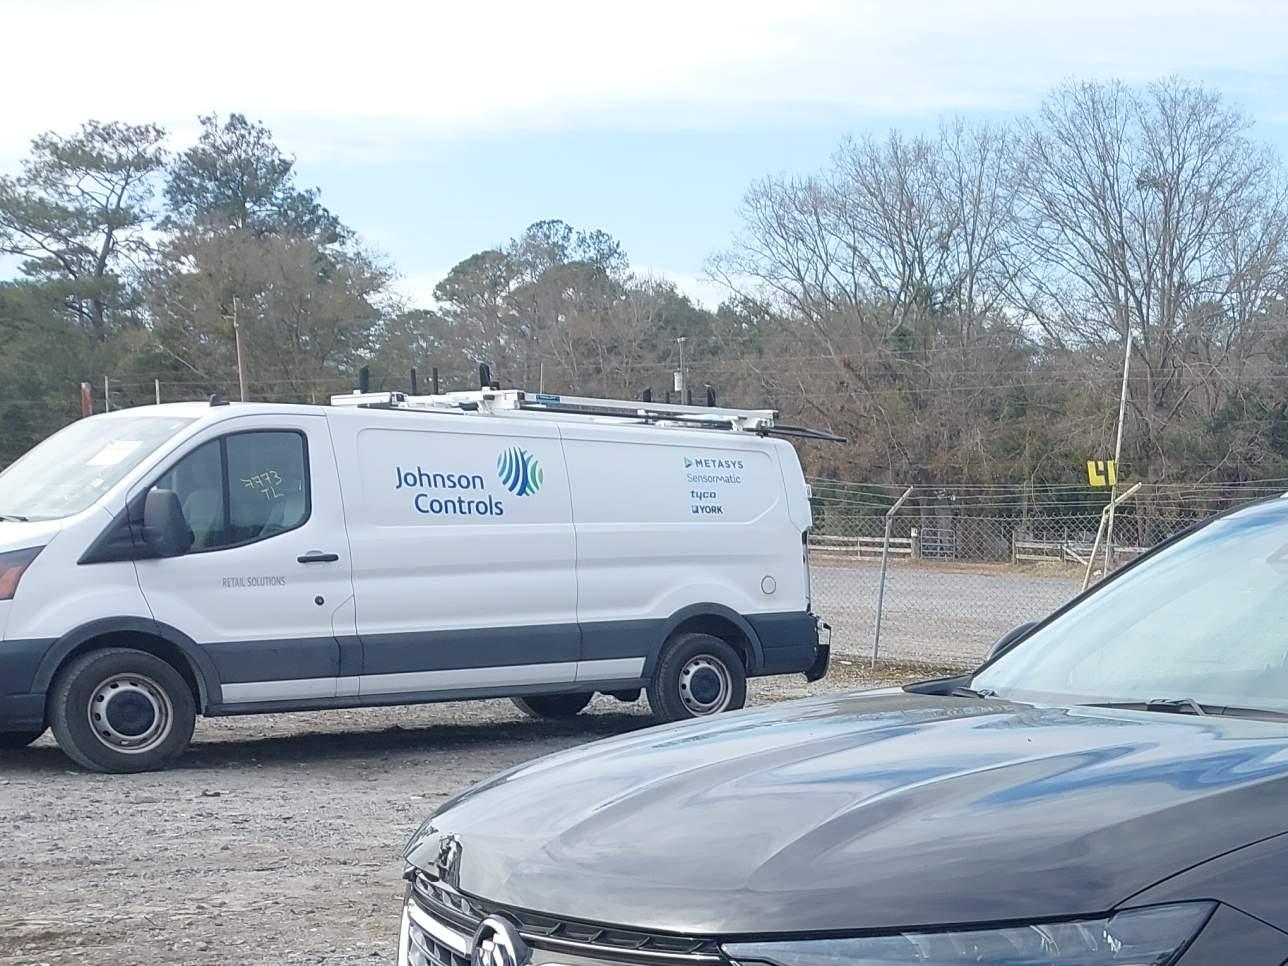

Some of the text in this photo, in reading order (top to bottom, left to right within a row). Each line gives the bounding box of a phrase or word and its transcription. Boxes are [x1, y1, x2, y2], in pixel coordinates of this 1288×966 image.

[694, 458, 744, 470] METASYS
[395, 465, 485, 490] Johnson
[690, 489, 717, 501] tyco
[414, 493, 504, 516] Controls
[699, 504, 724, 514] YORK
[222, 575, 286, 588] RETAIL SOLUTIONS
